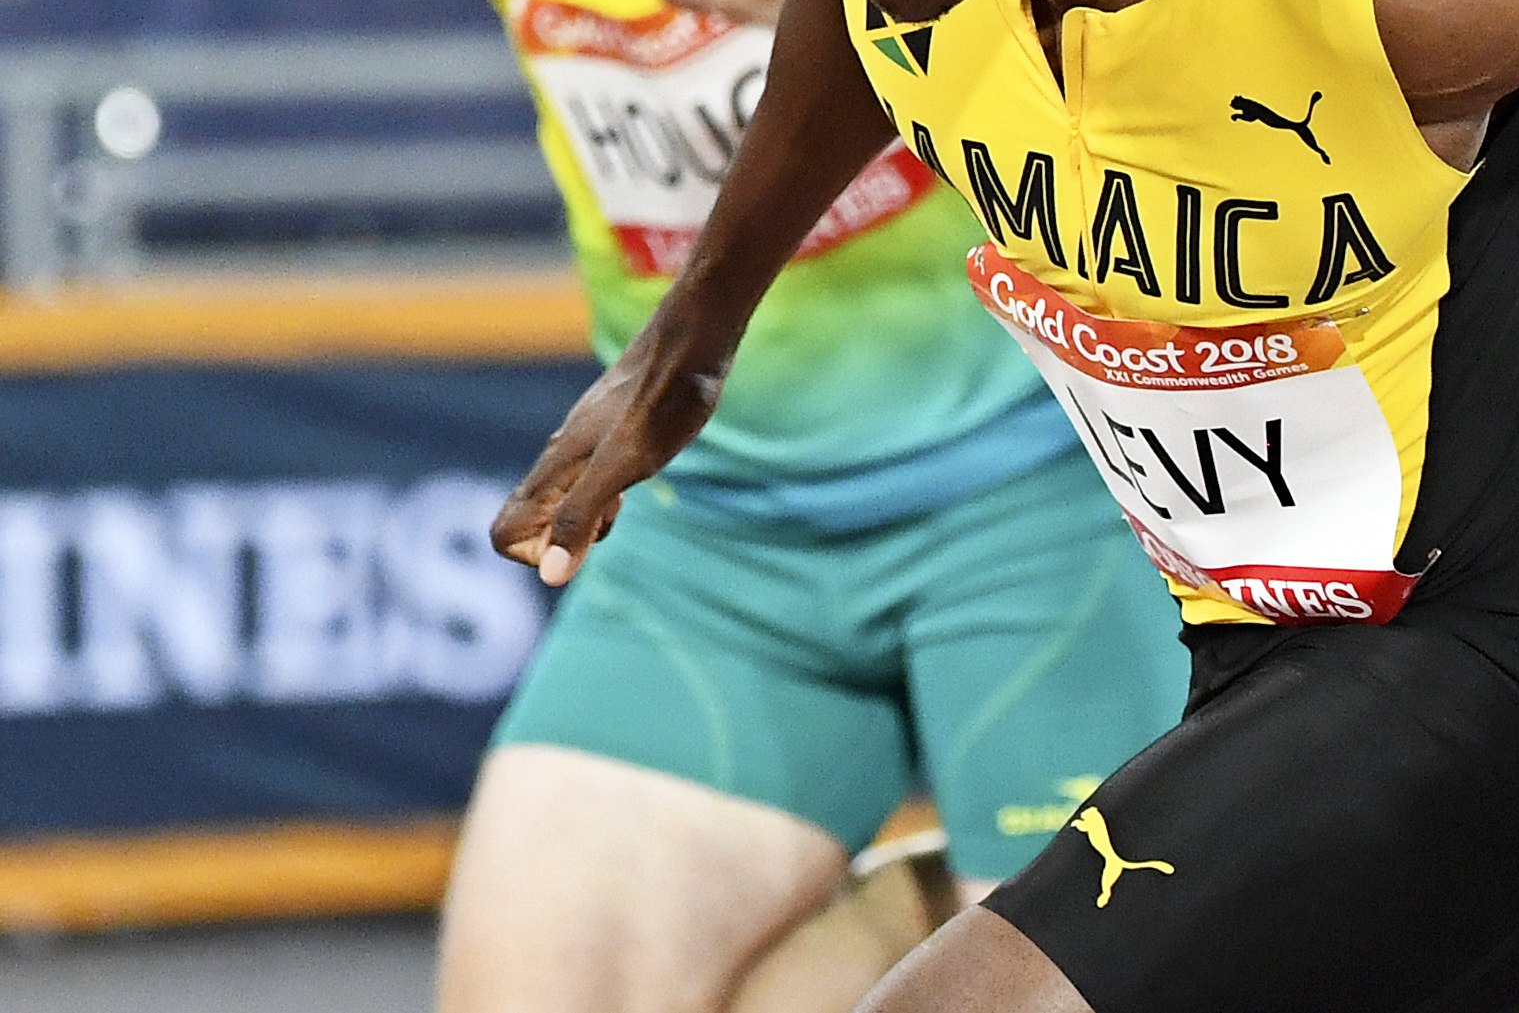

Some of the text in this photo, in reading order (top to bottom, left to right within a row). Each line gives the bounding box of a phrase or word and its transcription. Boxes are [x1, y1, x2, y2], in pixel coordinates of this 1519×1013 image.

[883, 97, 1397, 309] MAICA
[990, 272, 1298, 373] Gold Coast 2018
[1103, 361, 1309, 388] XXI Commonwealth Games
[1066, 384, 1296, 520] LEVY
